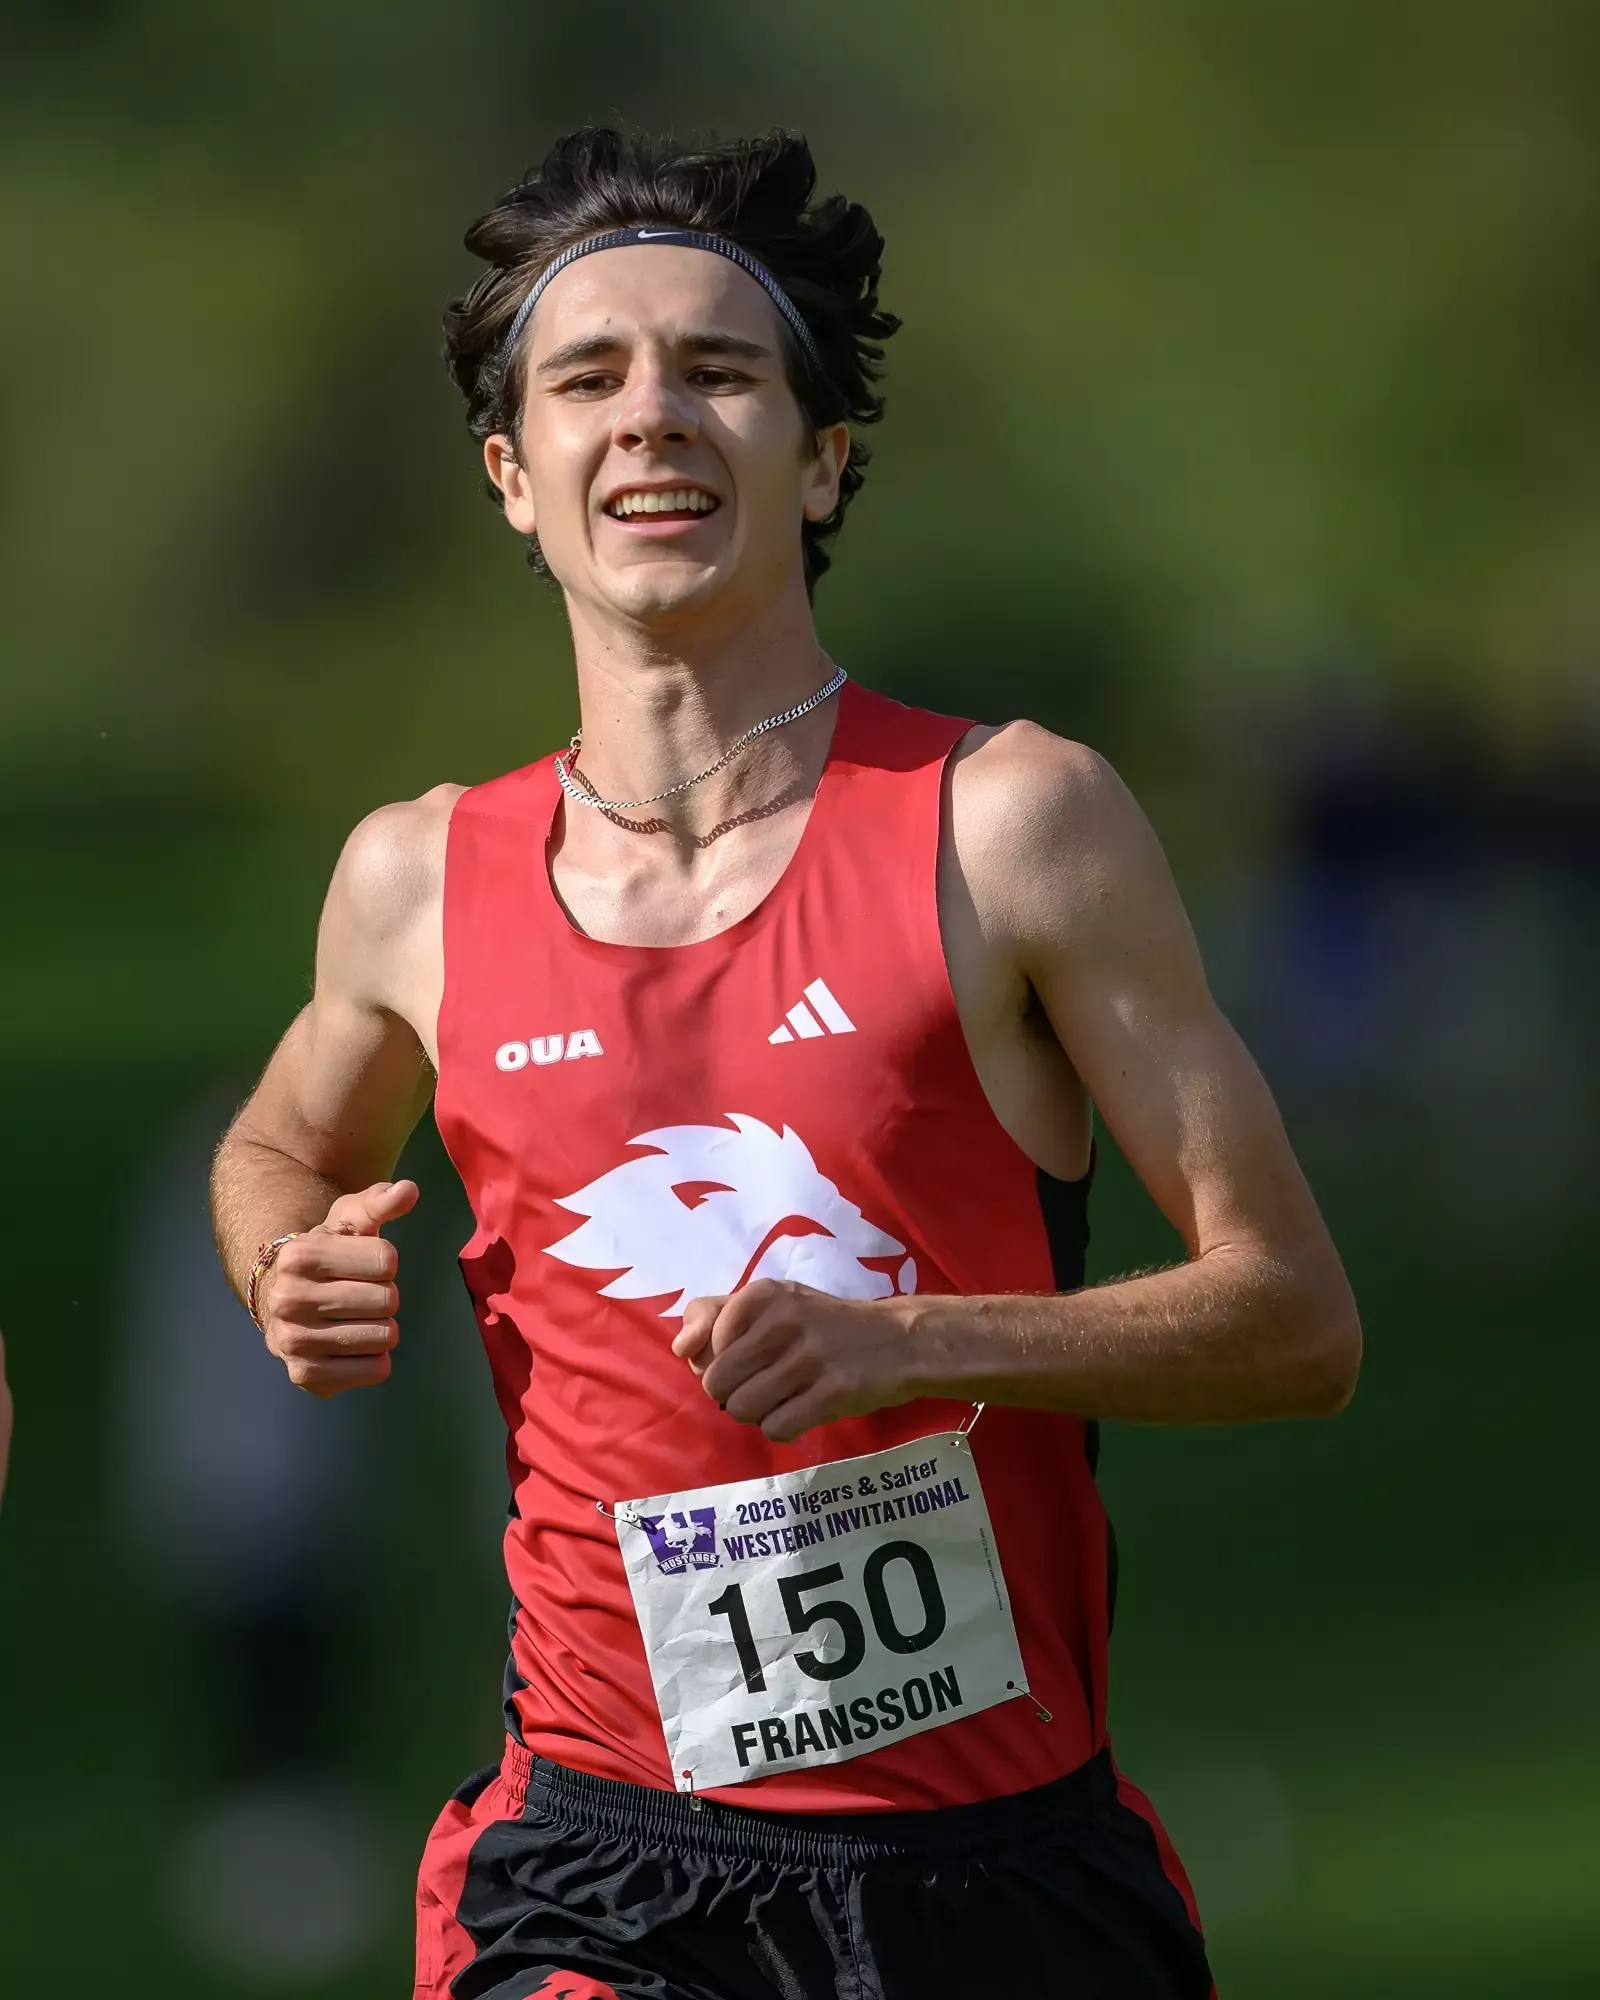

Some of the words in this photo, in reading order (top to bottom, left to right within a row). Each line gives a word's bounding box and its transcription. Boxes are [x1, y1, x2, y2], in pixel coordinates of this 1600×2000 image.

[495, 1029, 604, 1072] OUA
[723, 1518, 825, 1562] WESTERN
[826, 1477, 970, 1539] INVITATIONAL
[736, 1498, 787, 1525] 2026
[787, 1483, 854, 1515] Vigars
[858, 1475, 878, 1497] &
[880, 1457, 938, 1492] Salter
[659, 1552, 718, 1572] MUSTANGS
[708, 1540, 947, 1695] 150
[731, 1665, 964, 1767] FRANSSON
